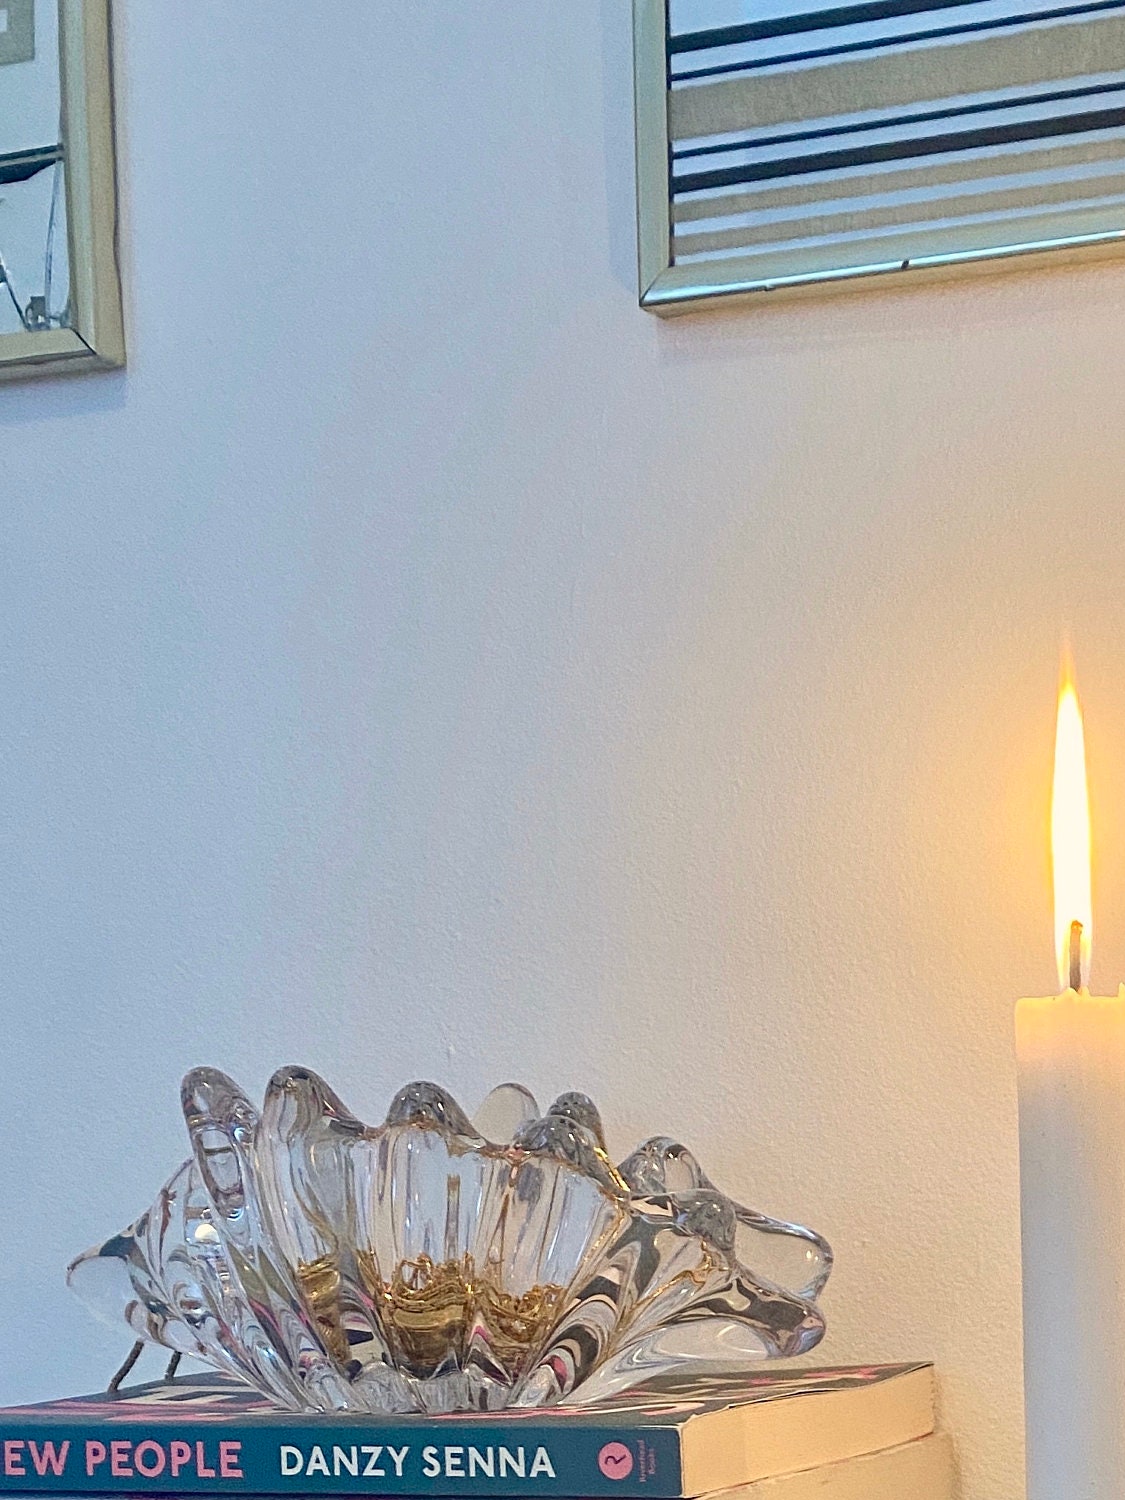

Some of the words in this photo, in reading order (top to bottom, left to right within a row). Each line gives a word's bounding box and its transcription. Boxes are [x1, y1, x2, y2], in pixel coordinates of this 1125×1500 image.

[85, 1439, 244, 1478] PEOPLE
[279, 1446, 411, 1477] DANZY
[422, 1446, 557, 1478] SENNA
